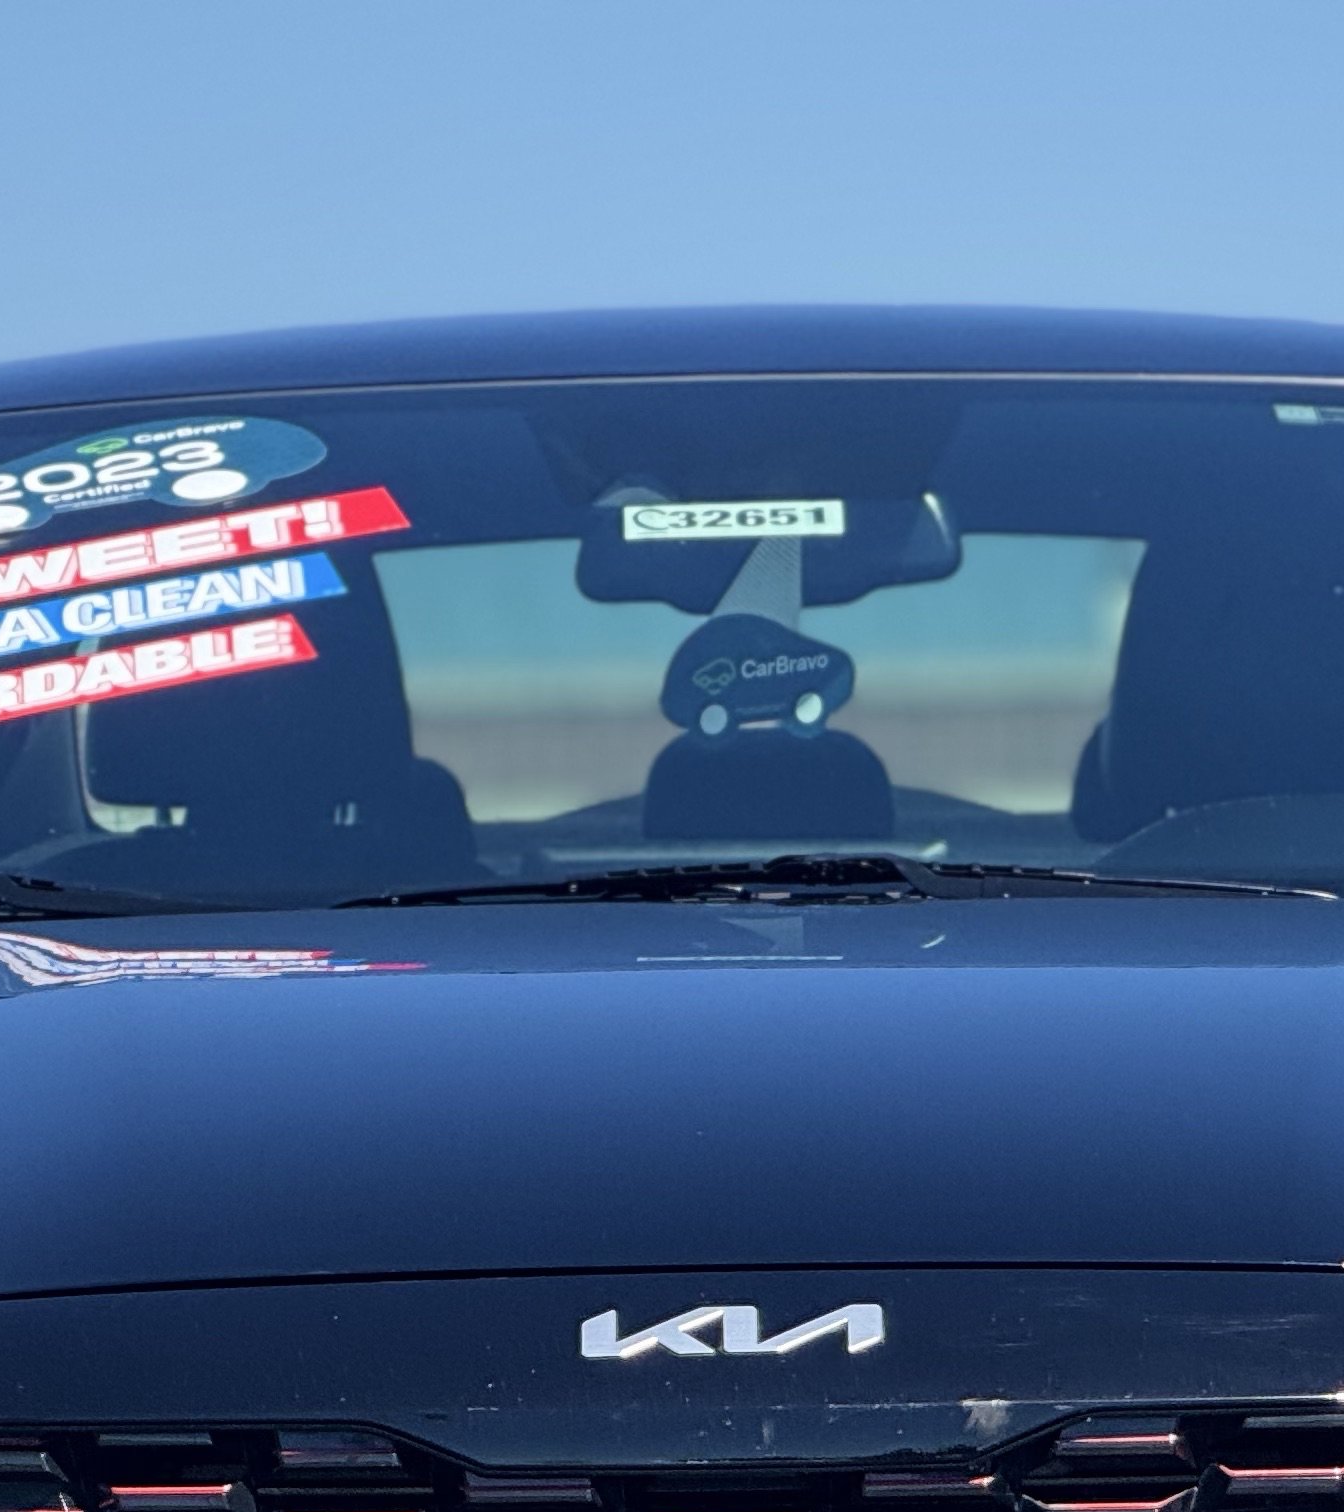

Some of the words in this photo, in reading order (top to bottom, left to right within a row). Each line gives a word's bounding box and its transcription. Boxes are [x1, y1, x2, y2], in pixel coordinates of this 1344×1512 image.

[133, 420, 246, 445] CarBravo
[43, 479, 152, 504] Certified
[62, 560, 305, 636] CLEAN
[740, 653, 830, 680] CarBravo
[580, 1303, 885, 1359] KIA
